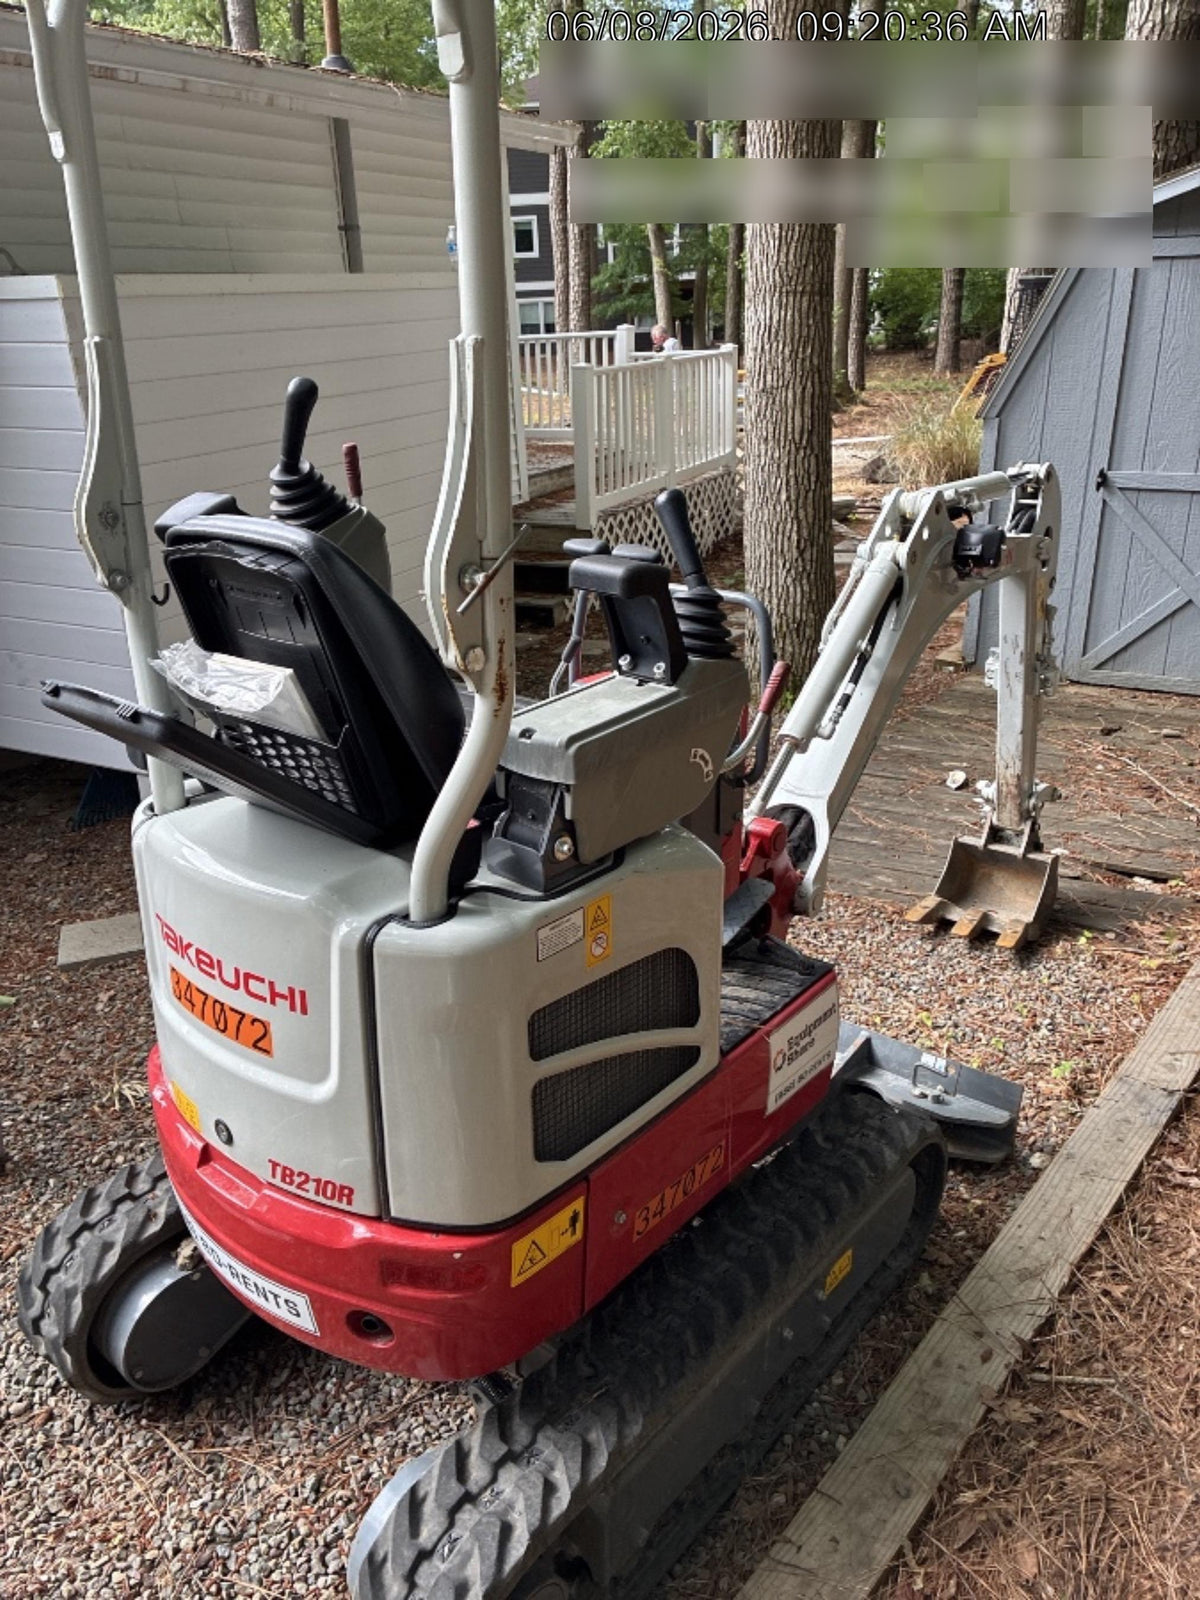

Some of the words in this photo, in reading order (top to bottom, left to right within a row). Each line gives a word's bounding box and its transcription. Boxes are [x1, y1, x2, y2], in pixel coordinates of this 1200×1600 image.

[170, 966, 272, 1054] 347072
[267, 1158, 355, 1206] TB210R
[635, 1144, 724, 1237] 347072
